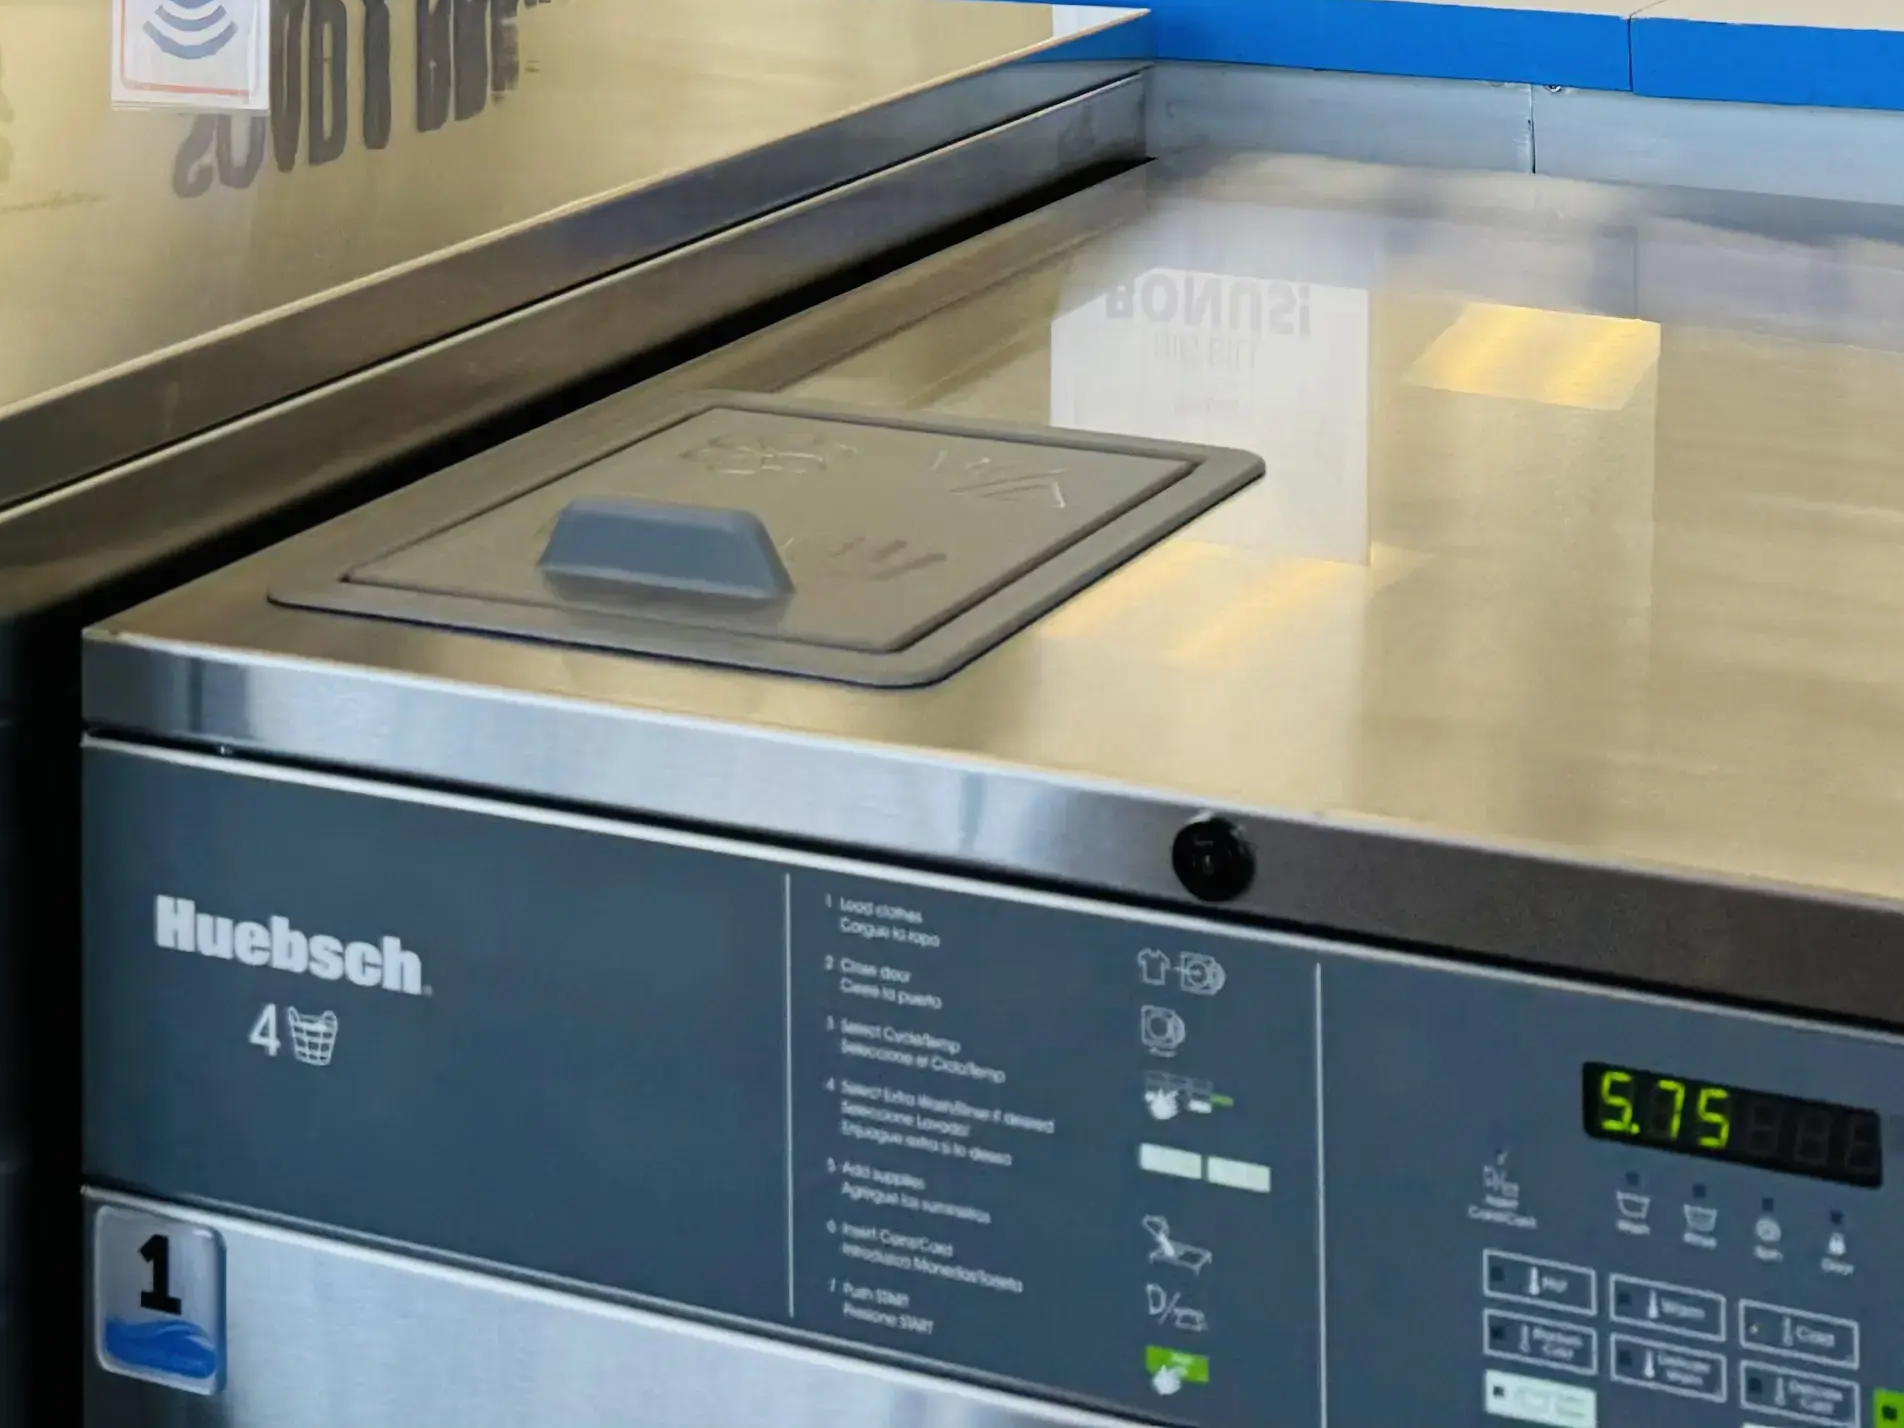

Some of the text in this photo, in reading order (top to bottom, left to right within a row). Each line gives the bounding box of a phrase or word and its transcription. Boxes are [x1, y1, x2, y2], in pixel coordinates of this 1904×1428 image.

[155, 894, 424, 996] Huebsch
[248, 1002, 282, 1057] 4
[1600, 1071, 1732, 1149] 5.75
[137, 1233, 183, 1316] 1
